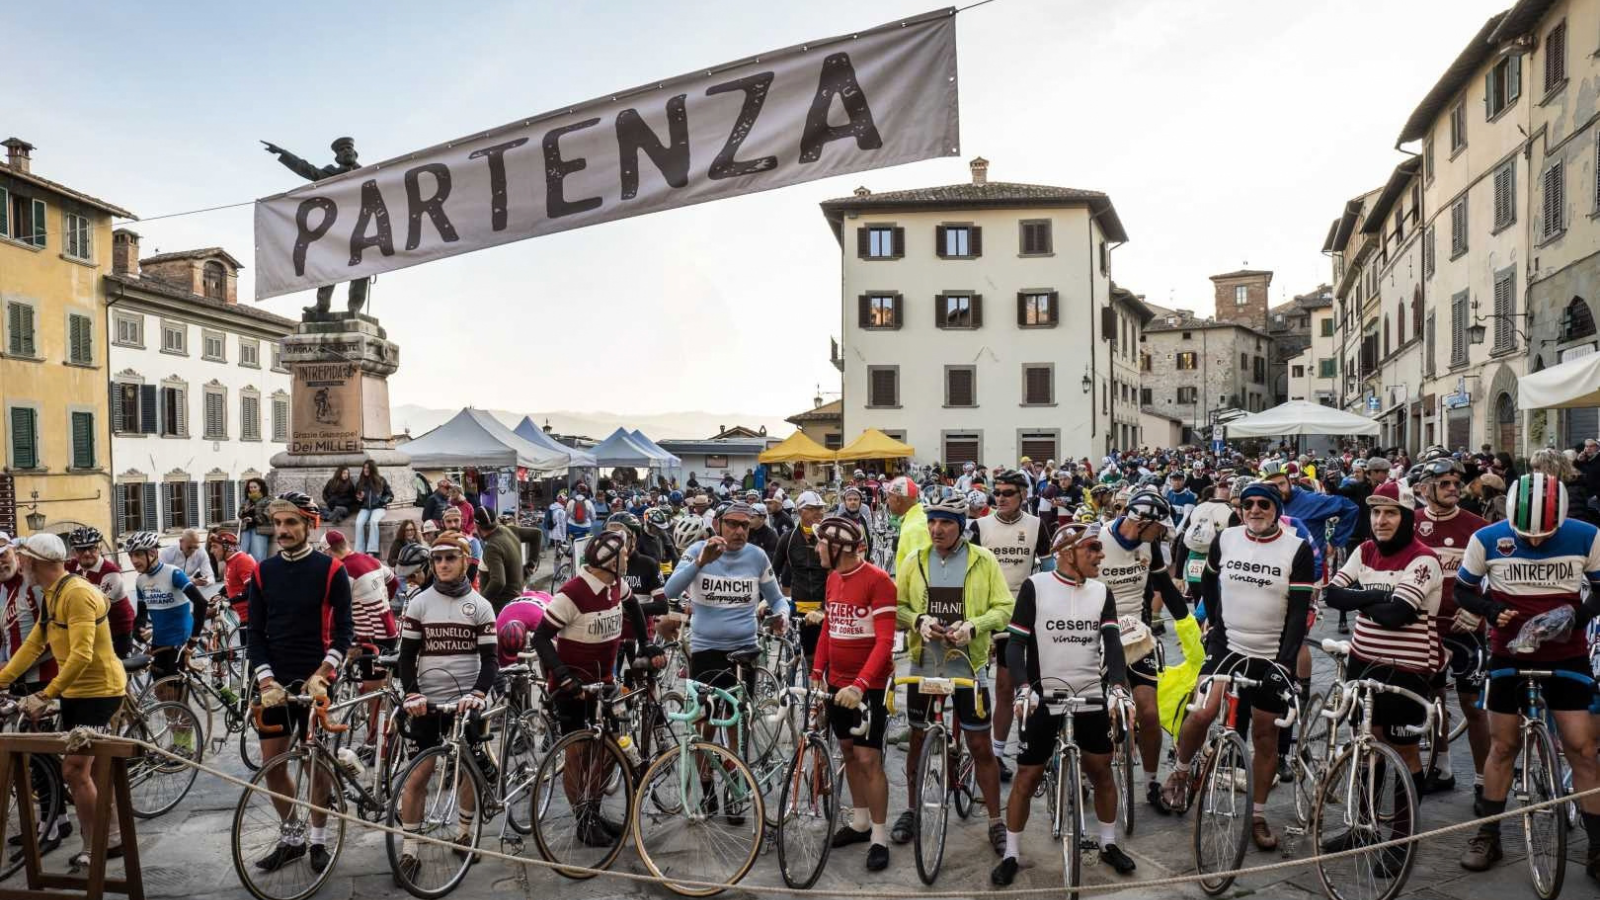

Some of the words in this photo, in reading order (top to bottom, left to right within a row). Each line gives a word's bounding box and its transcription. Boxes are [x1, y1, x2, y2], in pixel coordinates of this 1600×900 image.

[293, 51, 883, 277] PARTENZA
[293, 441, 312, 452] Dei
[989, 547, 1030, 556] esena
[1226, 560, 1282, 576] cesena
[701, 578, 753, 592] BIANCHI
[1229, 573, 1273, 587] vintage
[830, 603, 869, 618] ZIERO
[1046, 620, 1099, 631] cesena
[424, 627, 471, 639] BRUNELLO
[425, 640, 477, 652] MONTALCIN
[1053, 635, 1093, 646] vintage
